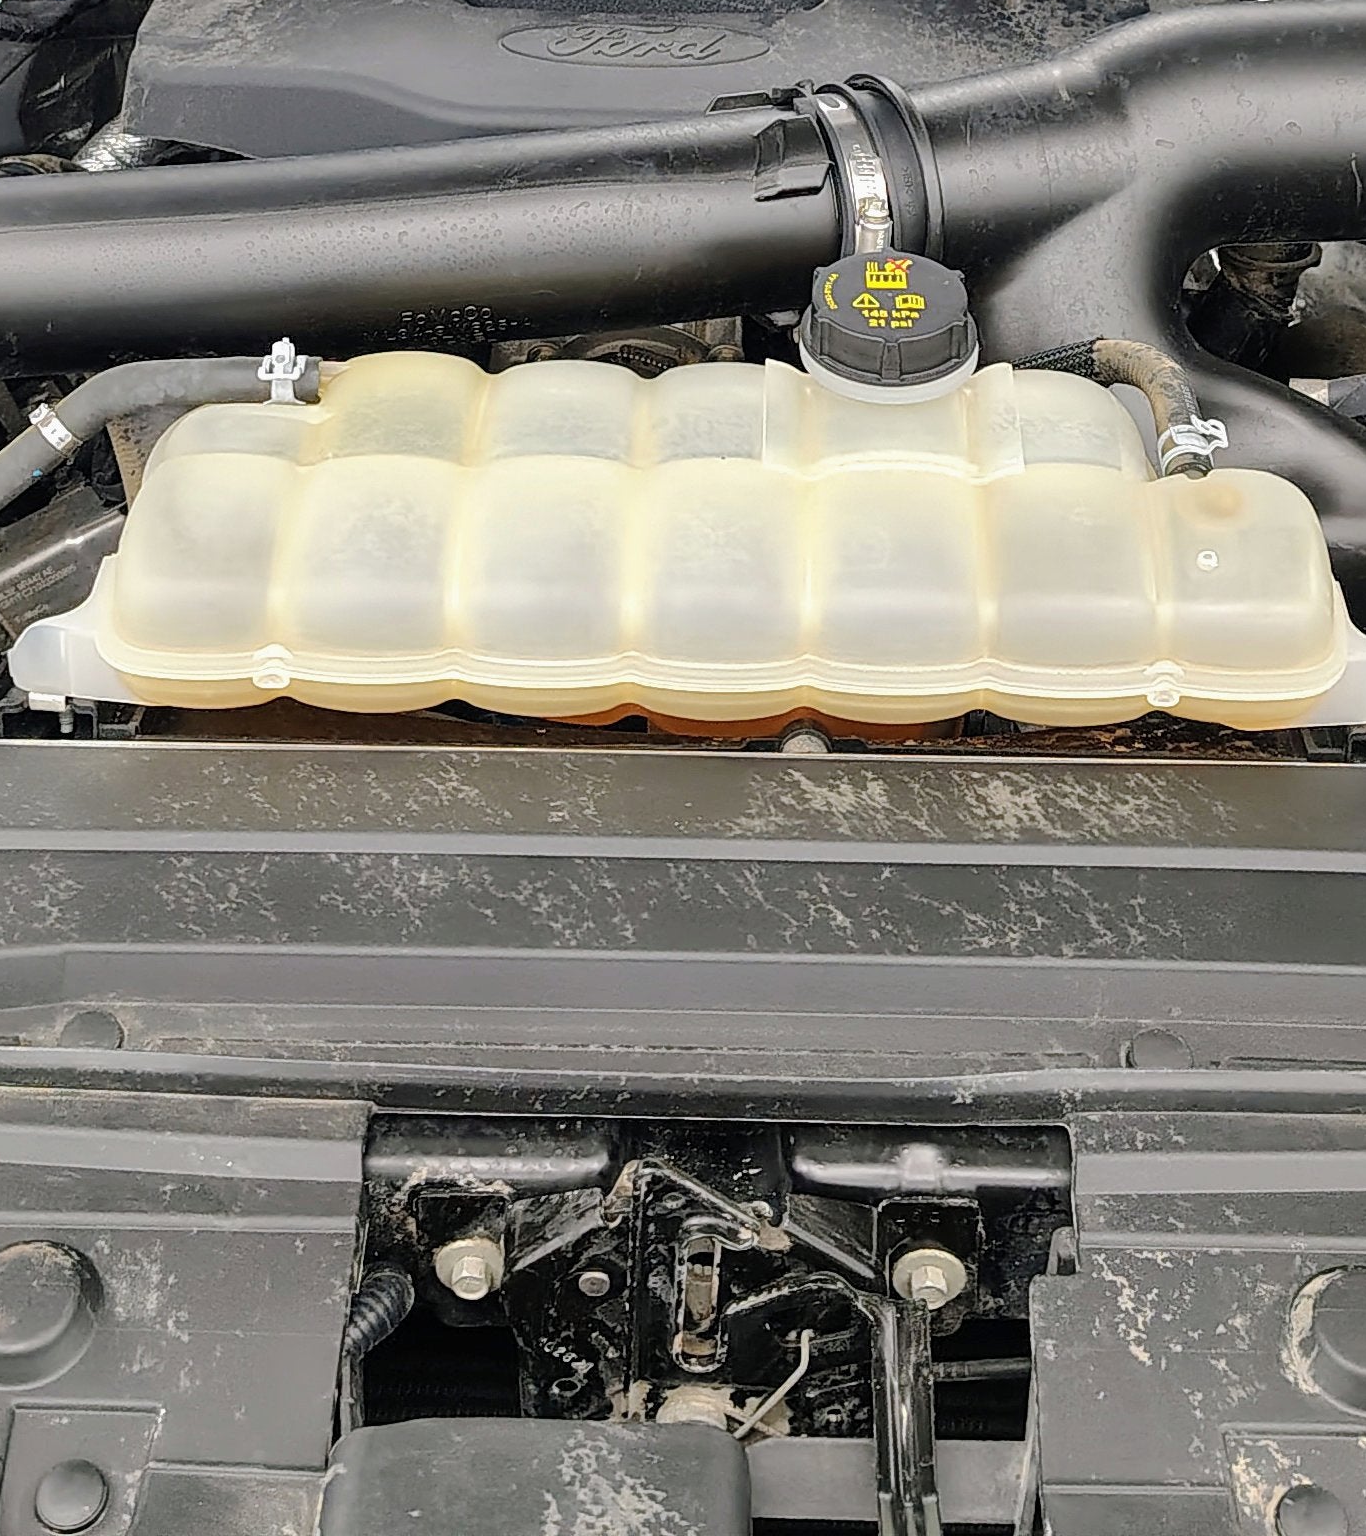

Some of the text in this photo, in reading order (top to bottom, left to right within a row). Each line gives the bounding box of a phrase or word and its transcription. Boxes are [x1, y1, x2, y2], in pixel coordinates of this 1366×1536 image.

[546, 24, 727, 60] Ford
[891, 309, 920, 319] kPa
[868, 318, 913, 329] 21 psi
